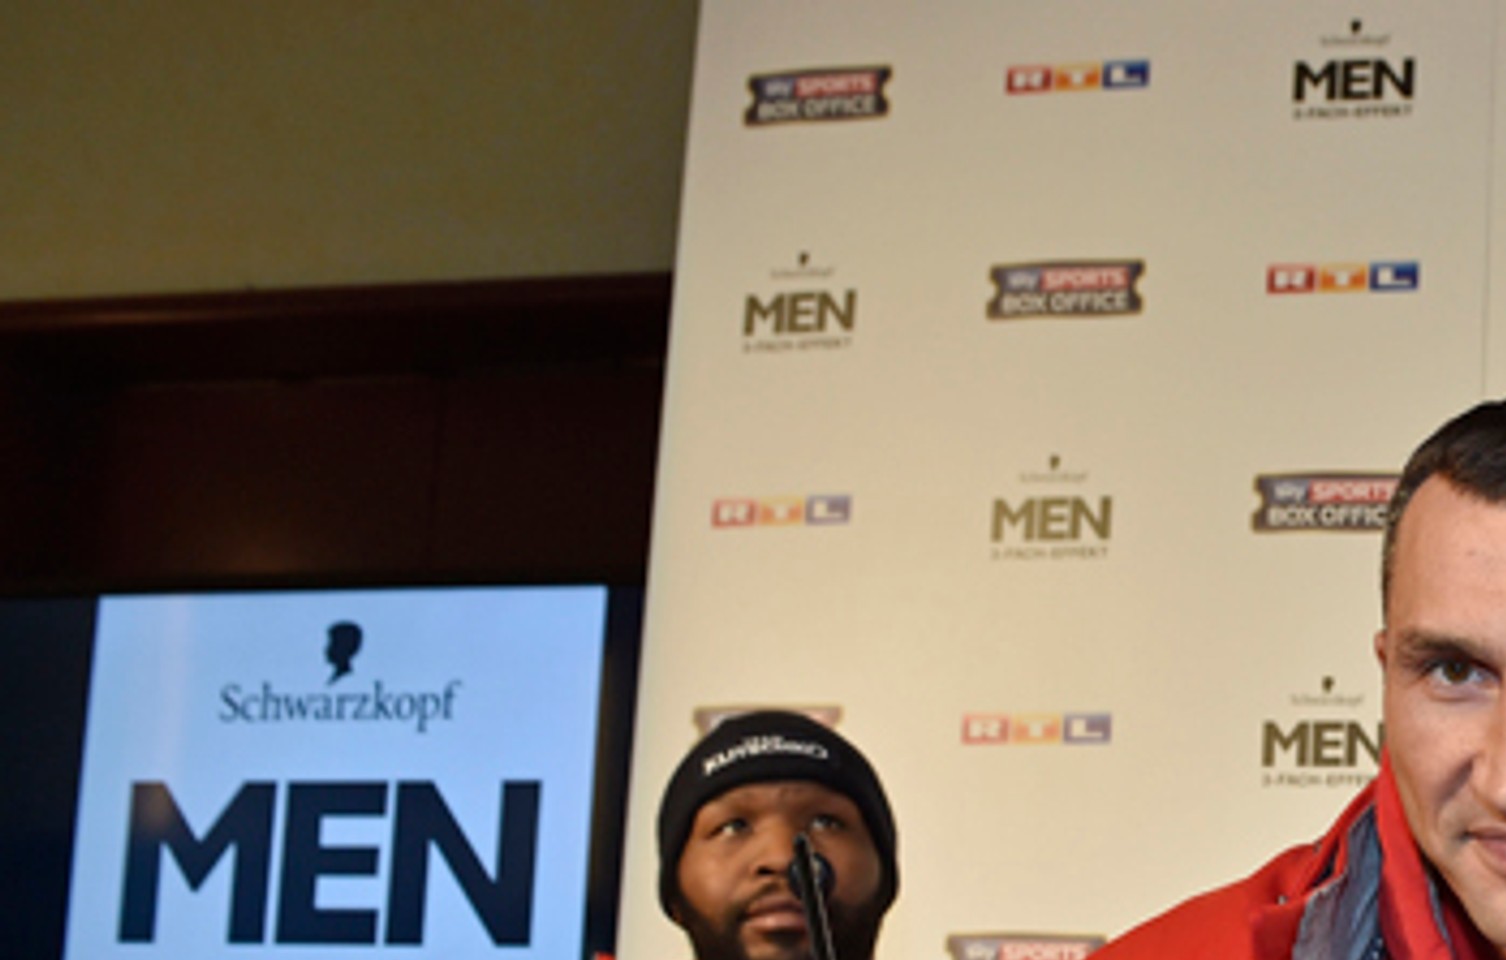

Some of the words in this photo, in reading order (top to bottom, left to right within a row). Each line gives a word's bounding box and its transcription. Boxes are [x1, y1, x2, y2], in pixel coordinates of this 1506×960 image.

[1008, 63, 1147, 92] RTL
[1293, 57, 1416, 102] MEN
[1269, 263, 1416, 292] RTL
[744, 289, 857, 336] MEN
[713, 498, 849, 525] RTL
[992, 496, 1112, 541] MEN
[1319, 504, 1388, 526] OFFIC
[219, 680, 462, 732] Schwarzkopf
[964, 716, 1109, 743] RTL
[1262, 720, 1384, 767] MEN
[116, 780, 543, 947] MEN
